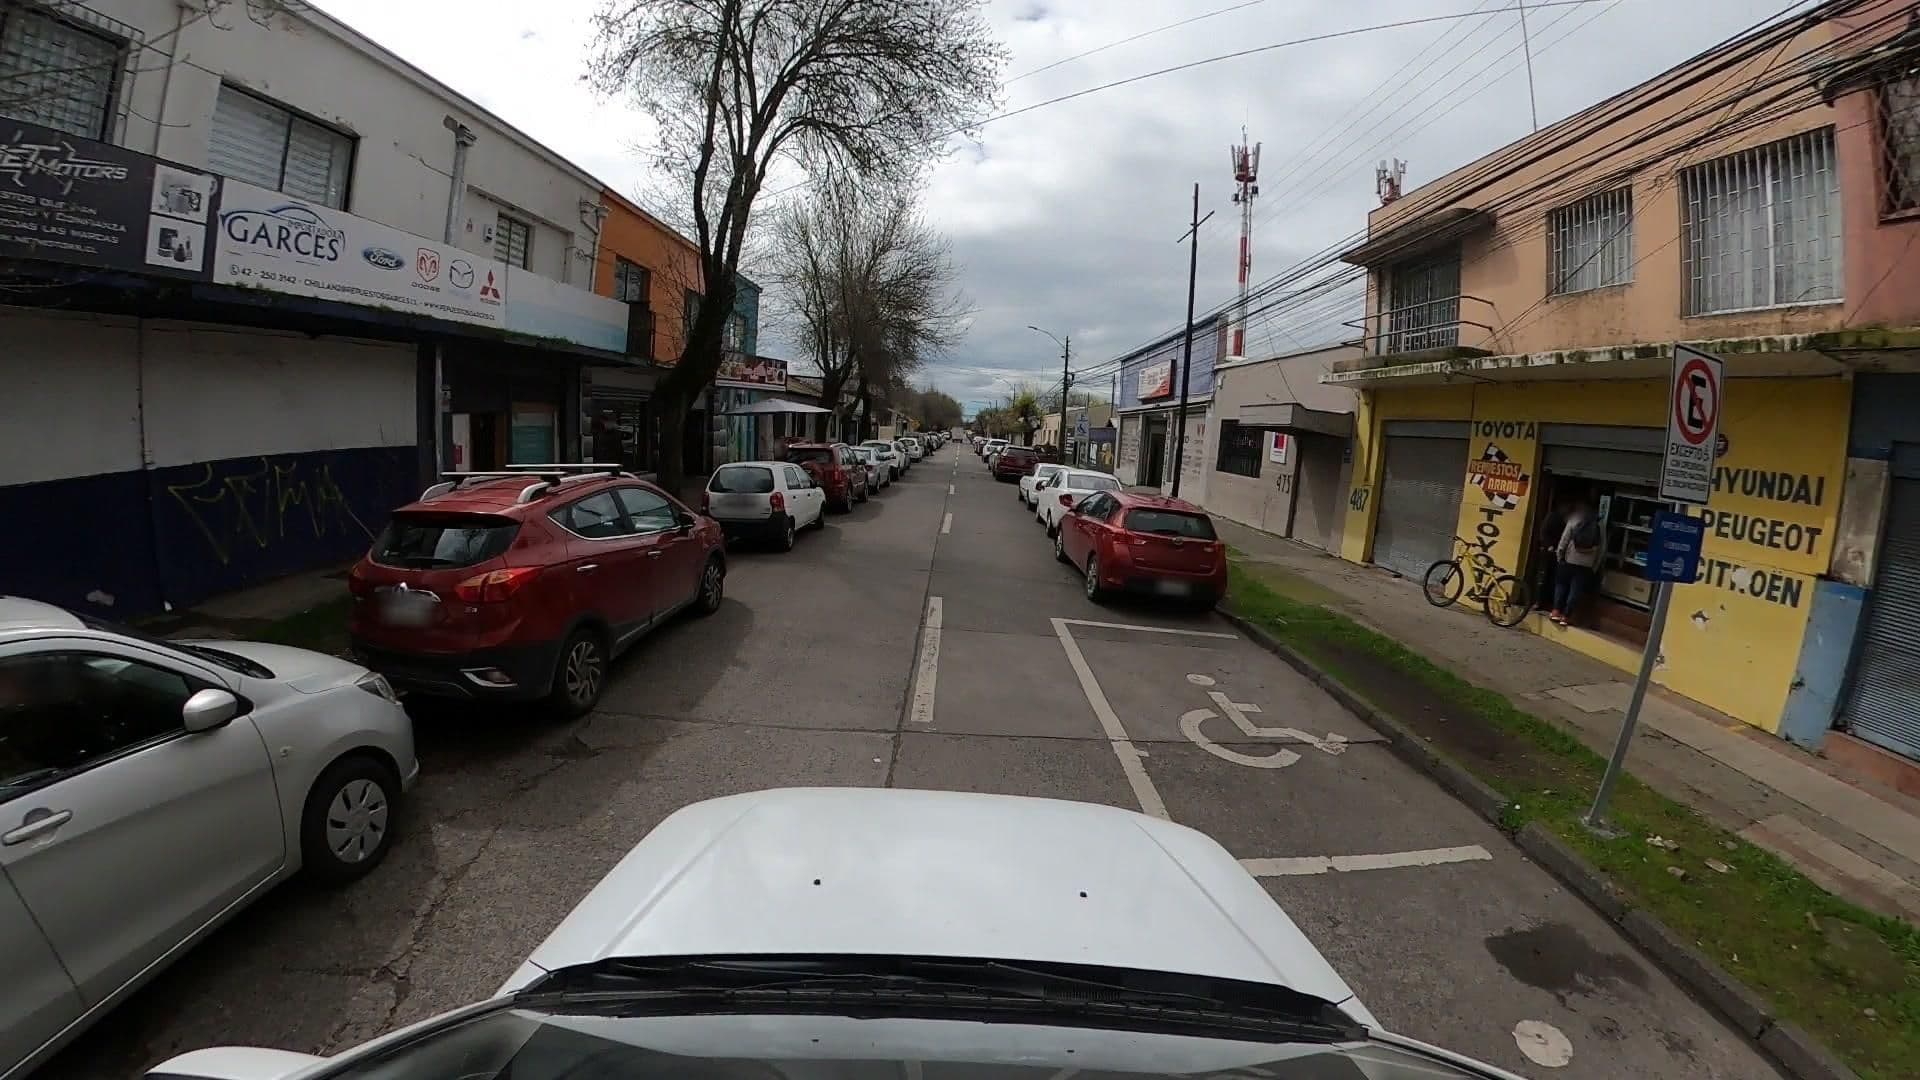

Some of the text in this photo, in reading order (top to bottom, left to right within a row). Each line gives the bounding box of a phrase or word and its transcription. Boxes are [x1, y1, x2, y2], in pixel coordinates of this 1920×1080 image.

[227, 215, 340, 262] GARCES
[1473, 421, 1535, 440] TOYOTA
[1350, 488, 1369, 512] 487
[1488, 478, 1519, 493] ARRAU
[1711, 466, 1826, 506] HYUNDAI
[1701, 508, 1823, 555] PEUGEOT
